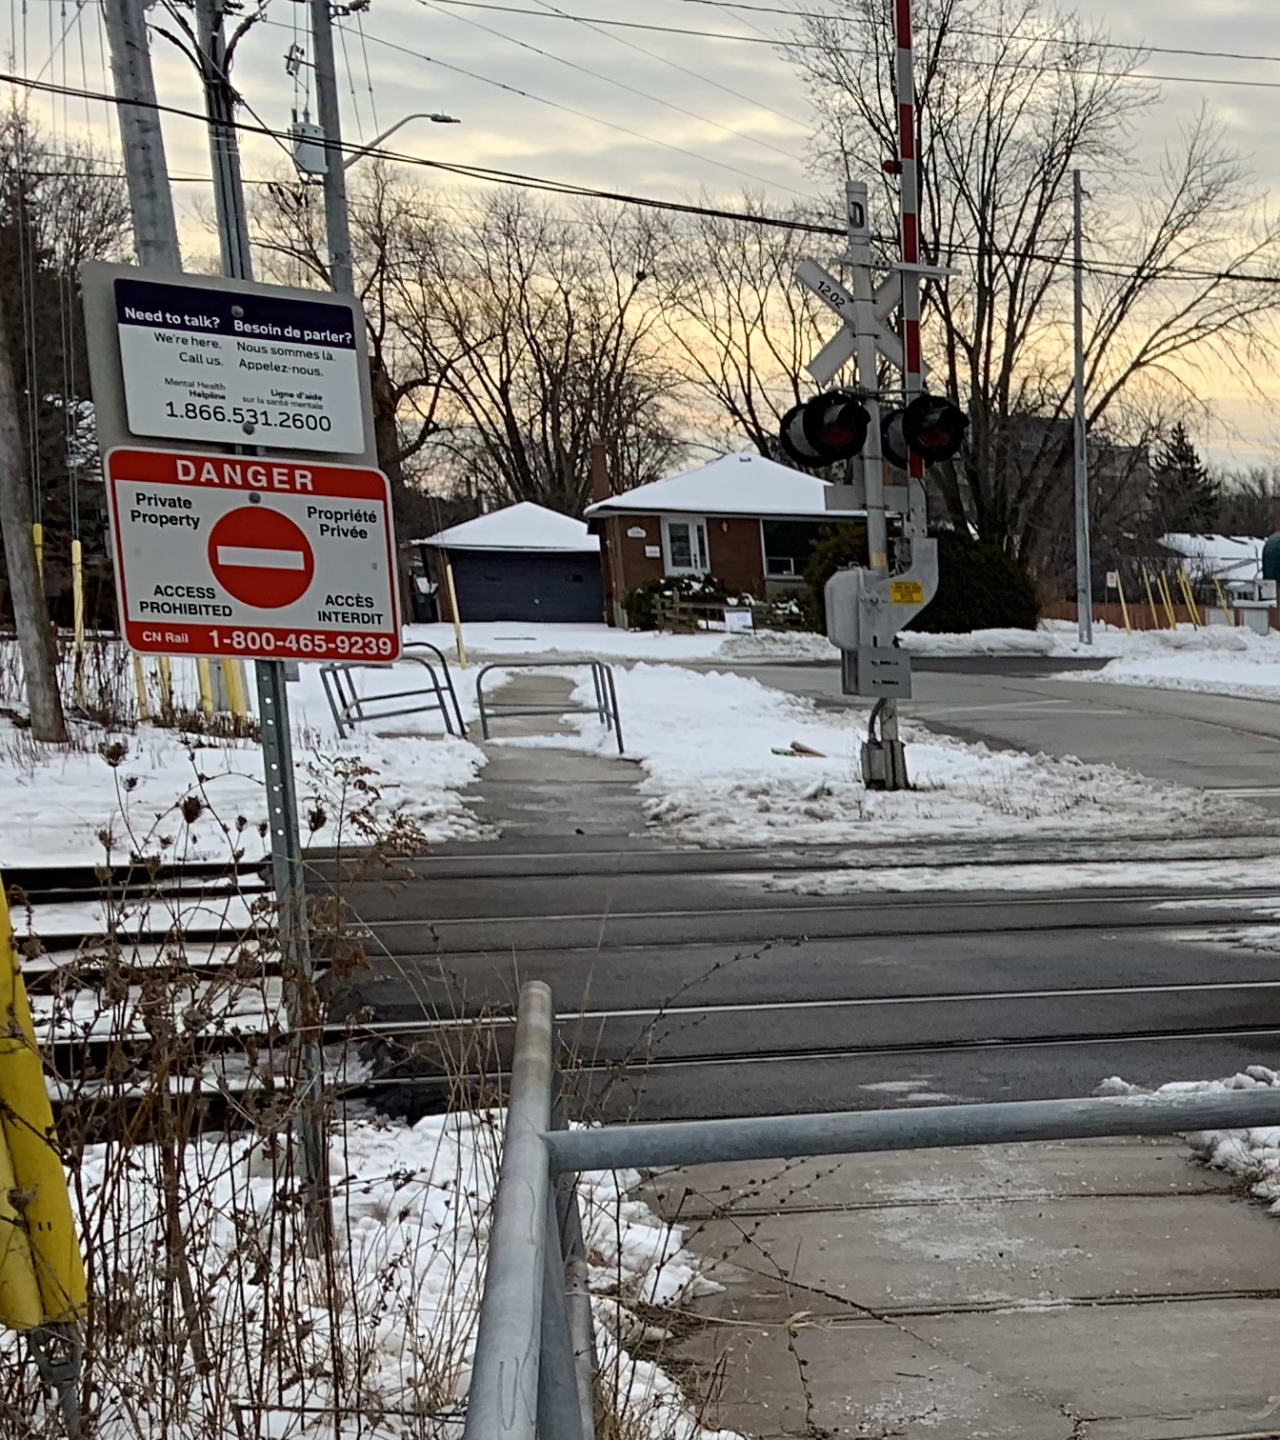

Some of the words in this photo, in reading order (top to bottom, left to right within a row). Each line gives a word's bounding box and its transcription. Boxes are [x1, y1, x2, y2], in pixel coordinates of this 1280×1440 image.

[124, 306, 163, 323] Need
[164, 312, 181, 325] to
[183, 314, 220, 329] talk?
[233, 319, 282, 336] Besoin
[283, 325, 302, 338] de
[303, 330, 353, 344] parler?
[154, 332, 189, 346] We're
[190, 336, 223, 350] here.
[179, 351, 204, 366] Call
[205, 356, 224, 367] us.
[236, 341, 268, 355] Nous
[270, 346, 321, 361] sommes
[322, 350, 337, 362] là.
[238, 357, 325, 378] Appelez-nous.
[164, 376, 195, 389] Mental
[196, 381, 226, 391] Health
[188, 389, 227, 401] Helpline
[270, 388, 295, 400] Ligne
[296, 391, 324, 402] d'aide
[165, 401, 332, 433] 1.866.531.2600
[175, 459, 314, 492] DANGER
[135, 492, 193, 510] Private
[130, 509, 201, 530] Property
[307, 505, 378, 524] Propriété
[319, 523, 369, 539] Privée
[153, 584, 217, 600] ACCESS
[325, 592, 375, 609] ACCÈS
[139, 600, 234, 618] PROHIBITED
[317, 609, 384, 626] INTERDIT
[142, 630, 162, 643] CN
[165, 631, 189, 644] Rail
[208, 629, 393, 656] 1-800-465-9239
